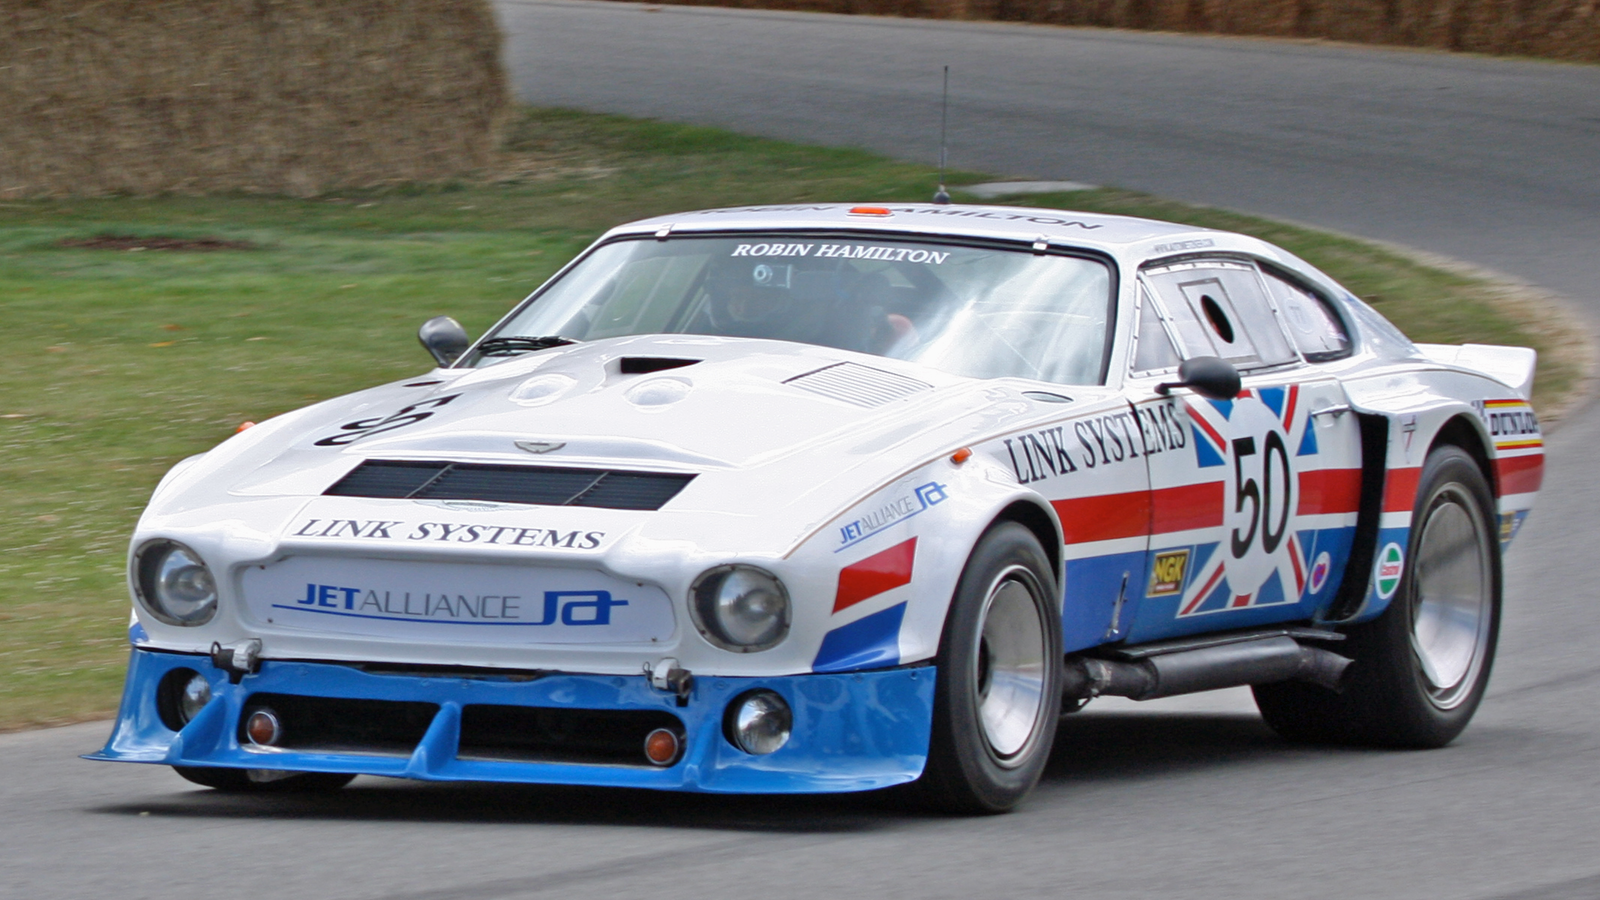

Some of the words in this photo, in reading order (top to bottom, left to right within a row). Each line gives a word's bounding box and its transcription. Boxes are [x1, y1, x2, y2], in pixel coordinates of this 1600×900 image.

[731, 243, 813, 259] ROBIN
[812, 243, 950, 266] HAMILTON
[1003, 425, 1078, 485] LINK
[1074, 401, 1186, 468] SYSTEMS
[1231, 430, 1290, 560] 50
[292, 518, 405, 539] LINK
[407, 521, 606, 550] SYSTEMS
[838, 496, 915, 545] JETALLIANCE
[1155, 555, 1186, 583] NGK
[297, 583, 521, 619] JETALLIANCE
